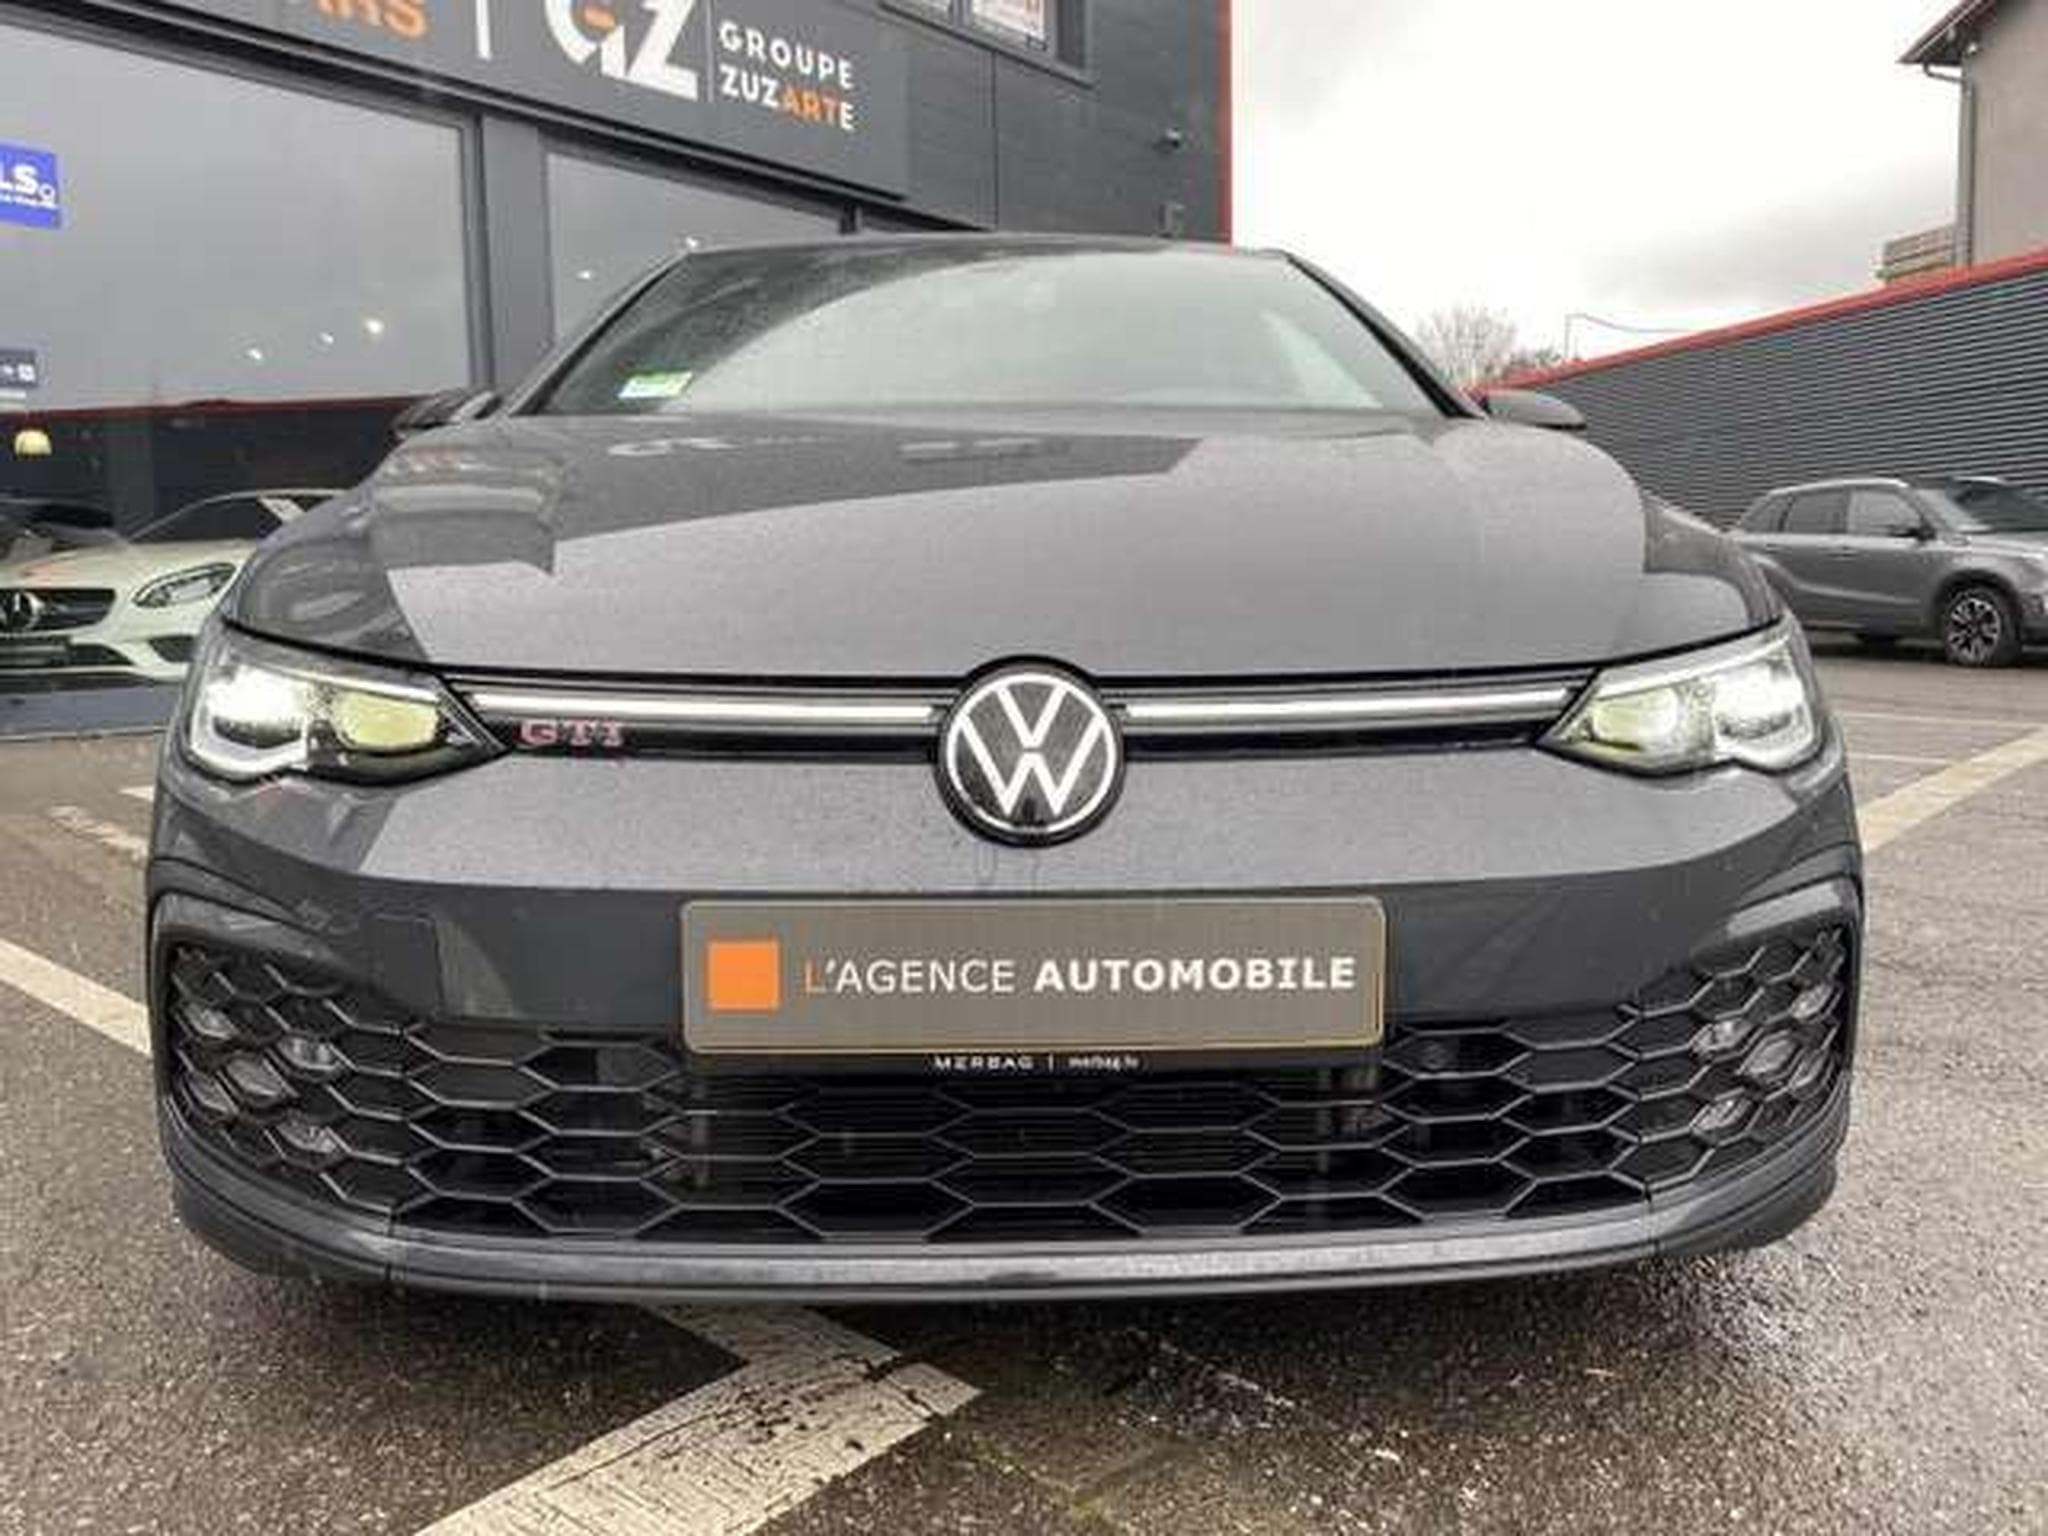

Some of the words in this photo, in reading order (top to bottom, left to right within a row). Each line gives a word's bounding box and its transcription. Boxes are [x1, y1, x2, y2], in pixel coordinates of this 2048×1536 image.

[719, 20, 854, 91] GROUPE
[719, 63, 855, 132] ZUZARTE
[519, 718, 625, 748] GTI
[804, 959, 1017, 994] L'AGENCE
[1034, 956, 1355, 992] AUTOMOBILE
[933, 1055, 1034, 1071] MERBAG
